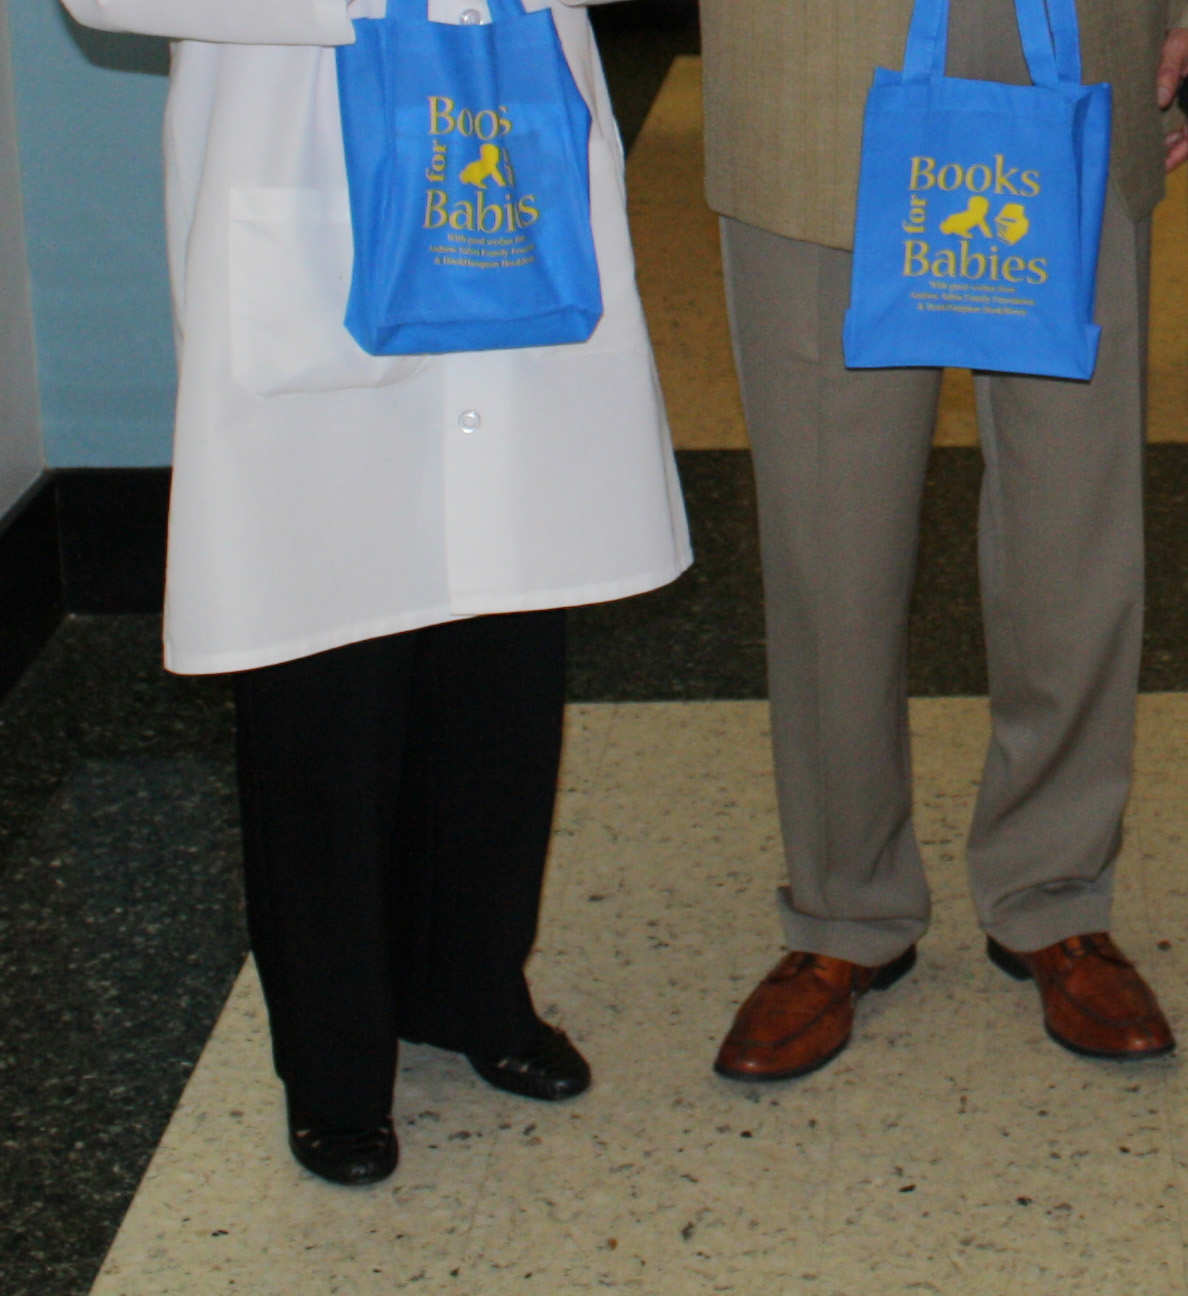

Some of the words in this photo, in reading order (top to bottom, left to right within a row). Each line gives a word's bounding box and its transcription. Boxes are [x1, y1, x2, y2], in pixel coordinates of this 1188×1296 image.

[425, 140, 448, 183] for
[908, 153, 1041, 197] Books
[902, 194, 927, 234] for
[902, 238, 1049, 284] Babies
